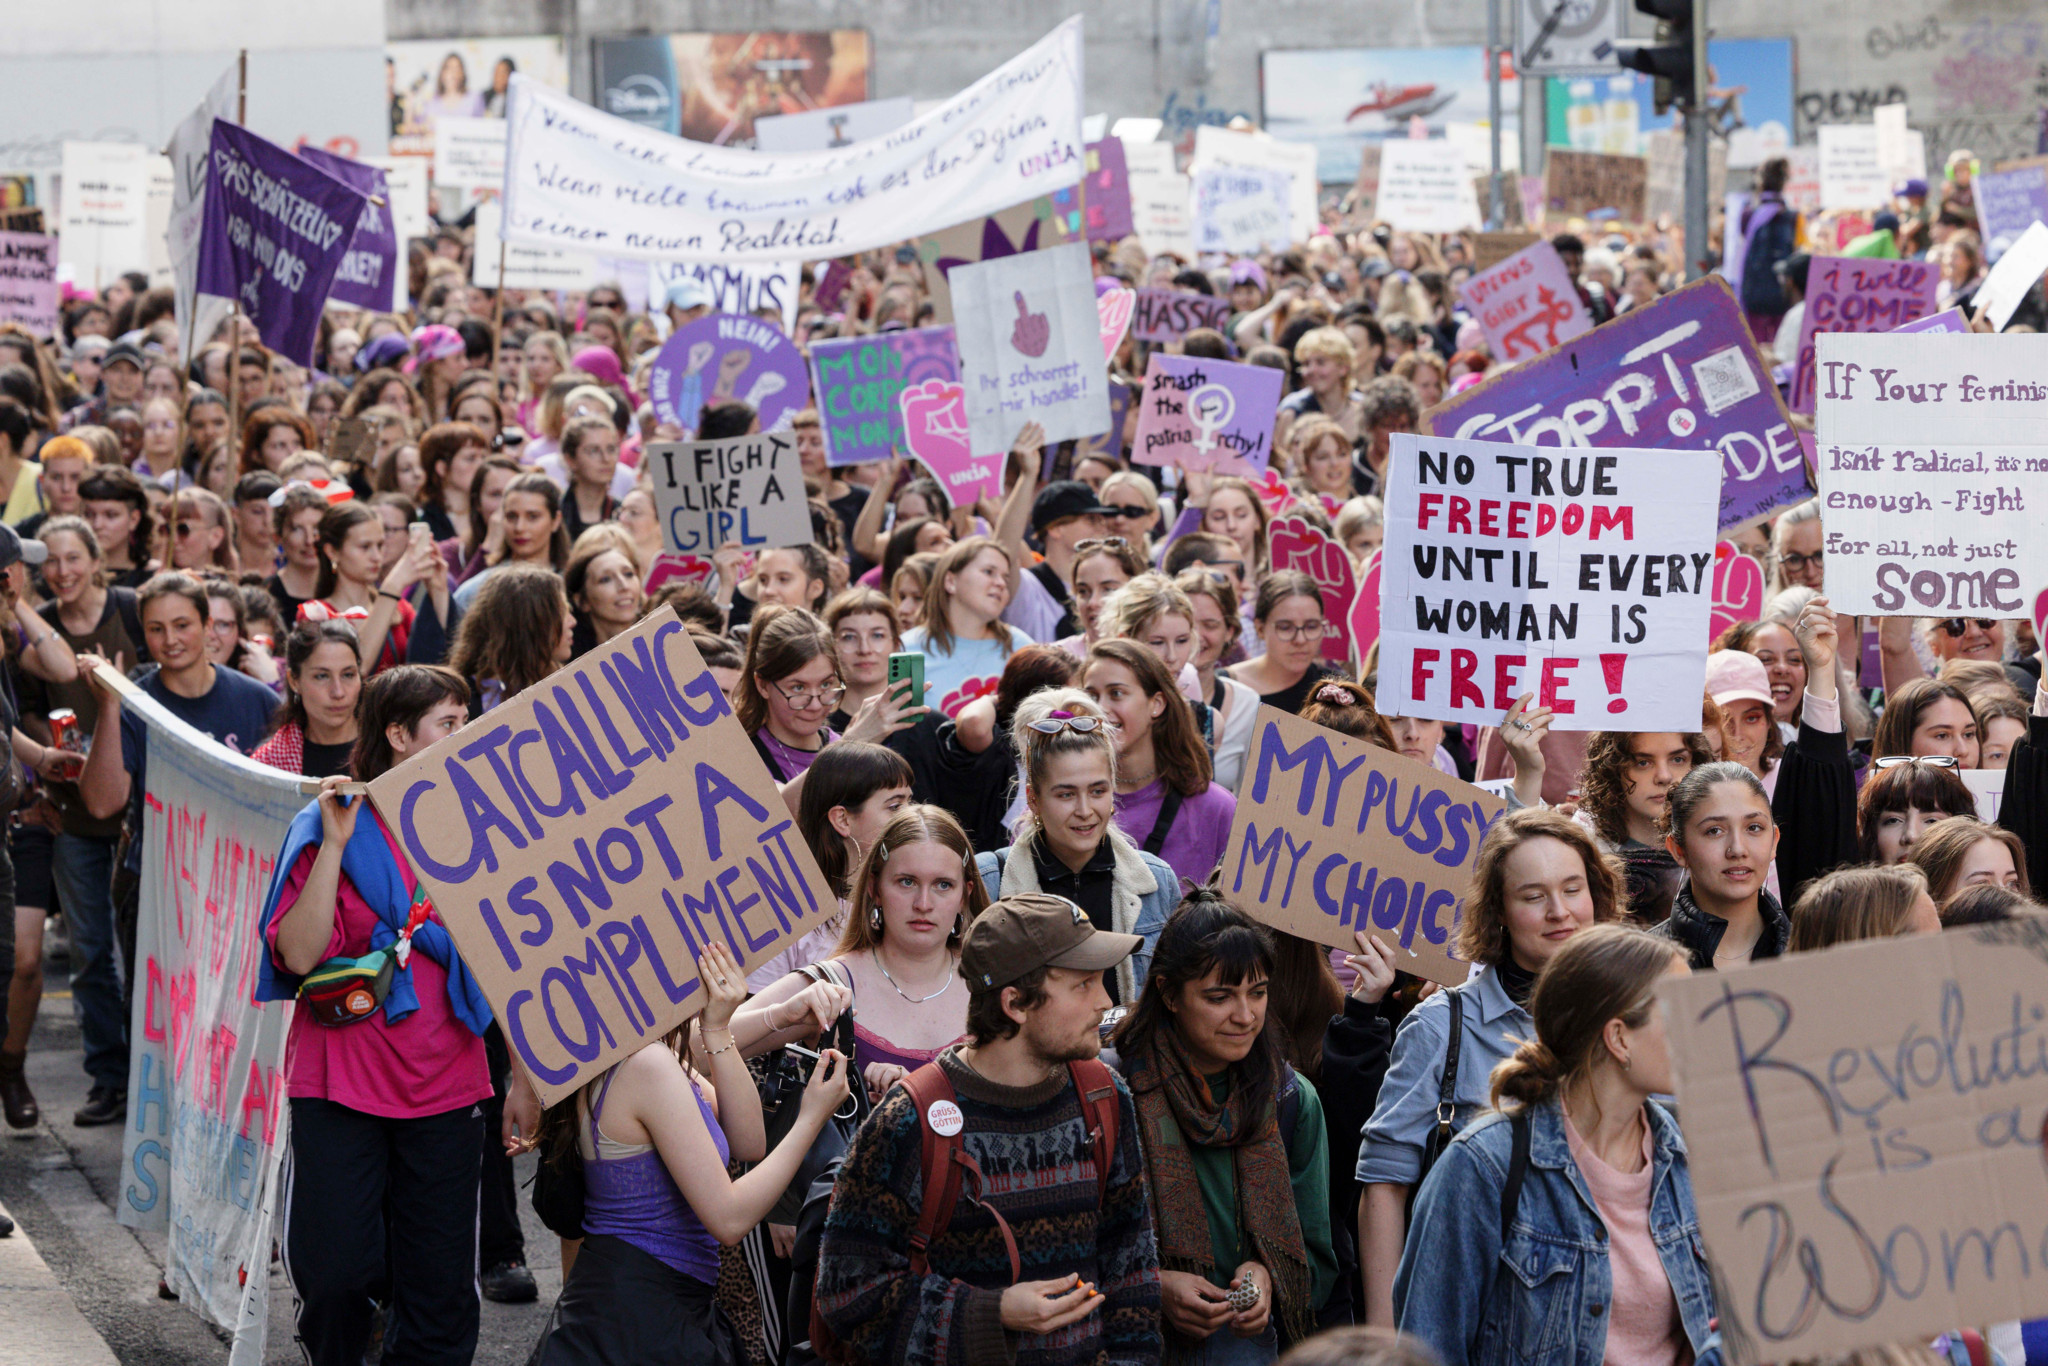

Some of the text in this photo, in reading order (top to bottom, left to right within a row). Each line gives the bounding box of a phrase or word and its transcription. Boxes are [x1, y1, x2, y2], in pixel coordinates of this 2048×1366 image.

[1851, 263, 1928, 297] will
[1812, 292, 1927, 327] COME
[718, 317, 782, 353] NEIN!
[818, 342, 903, 384] MON
[1152, 369, 1207, 392] smash
[1822, 361, 1862, 400] If
[1869, 368, 1948, 404] Your
[1958, 374, 2048, 403] feminis
[1155, 401, 1184, 416] the
[830, 416, 891, 453] MON
[662, 436, 791, 488] I FIGHT
[1418, 450, 1618, 497] NO TRUE
[1994, 455, 2022, 472] it's
[683, 474, 785, 512] LIKE A
[1826, 490, 1934, 513] enough
[669, 506, 768, 551] GIRL
[1417, 492, 1634, 541] FREEDOM
[1413, 544, 1712, 598] UNTIL EVERY
[1921, 537, 1959, 557] not
[1964, 539, 2019, 562] just
[1872, 562, 2024, 611] Some
[1415, 595, 1648, 645] WOMAN IS
[400, 620, 733, 884] CATCALLING
[1250, 720, 1505, 873] MY PUSSY
[478, 761, 771, 973] IS NOT A
[1232, 821, 1313, 909] MY
[505, 819, 820, 1087] COMPLIMENT
[1698, 978, 2048, 1180] Revoluti
[930, 1105, 957, 1119] GRÜSS
[932, 1115, 962, 1129] GÖTTIN
[1866, 1114, 1933, 1176] is
[1736, 1152, 2048, 1342] Wom
